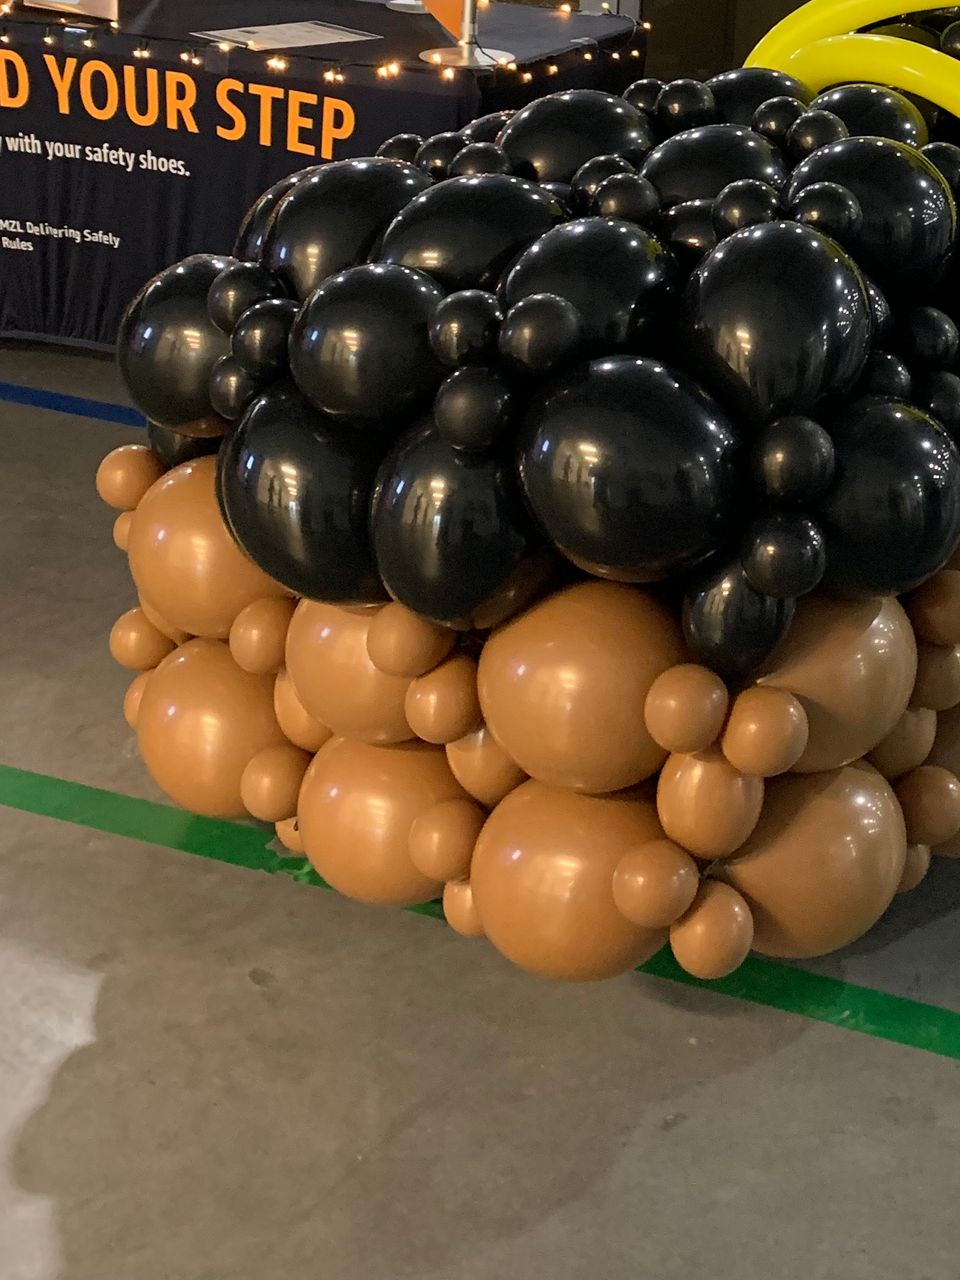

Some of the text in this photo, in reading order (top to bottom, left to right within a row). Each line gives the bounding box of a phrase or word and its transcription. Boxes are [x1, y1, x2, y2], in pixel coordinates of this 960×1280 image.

[43, 54, 199, 134] YOUR
[216, 78, 356, 160] STEP
[5, 132, 191, 177] with your safety shoes.
[1, 236, 34, 251] Rules
[26, 221, 81, 243] Delivering
[83, 229, 120, 249] Safely
